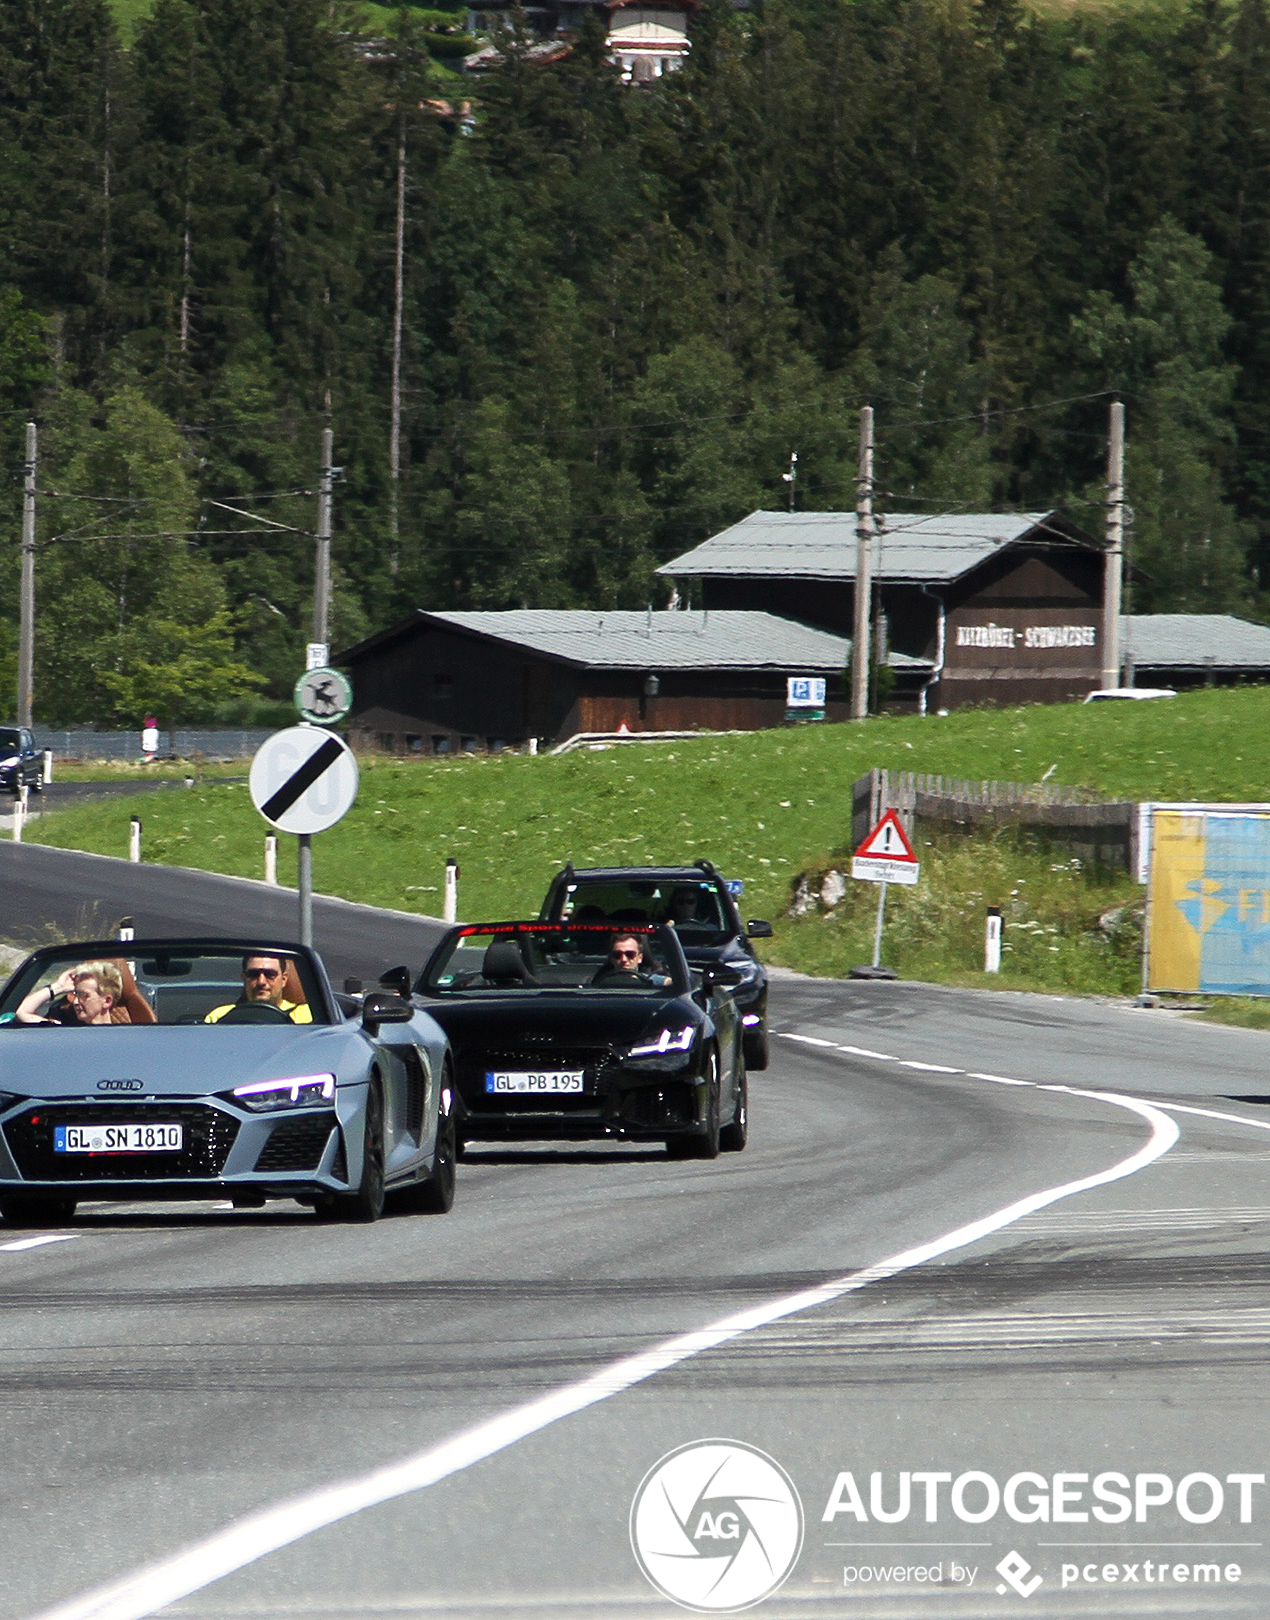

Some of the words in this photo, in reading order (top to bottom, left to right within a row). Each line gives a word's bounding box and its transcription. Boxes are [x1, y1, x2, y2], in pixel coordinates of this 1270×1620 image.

[480, 926, 515, 935] Audi
[518, 924, 562, 932] Sport
[567, 924, 620, 932] drivers
[496, 1075, 516, 1090] GL
[528, 1075, 547, 1090] PB
[551, 1074, 581, 1090] 195
[67, 1129, 90, 1148] GL
[105, 1128, 128, 1148] SN
[133, 1127, 179, 1148] 1810
